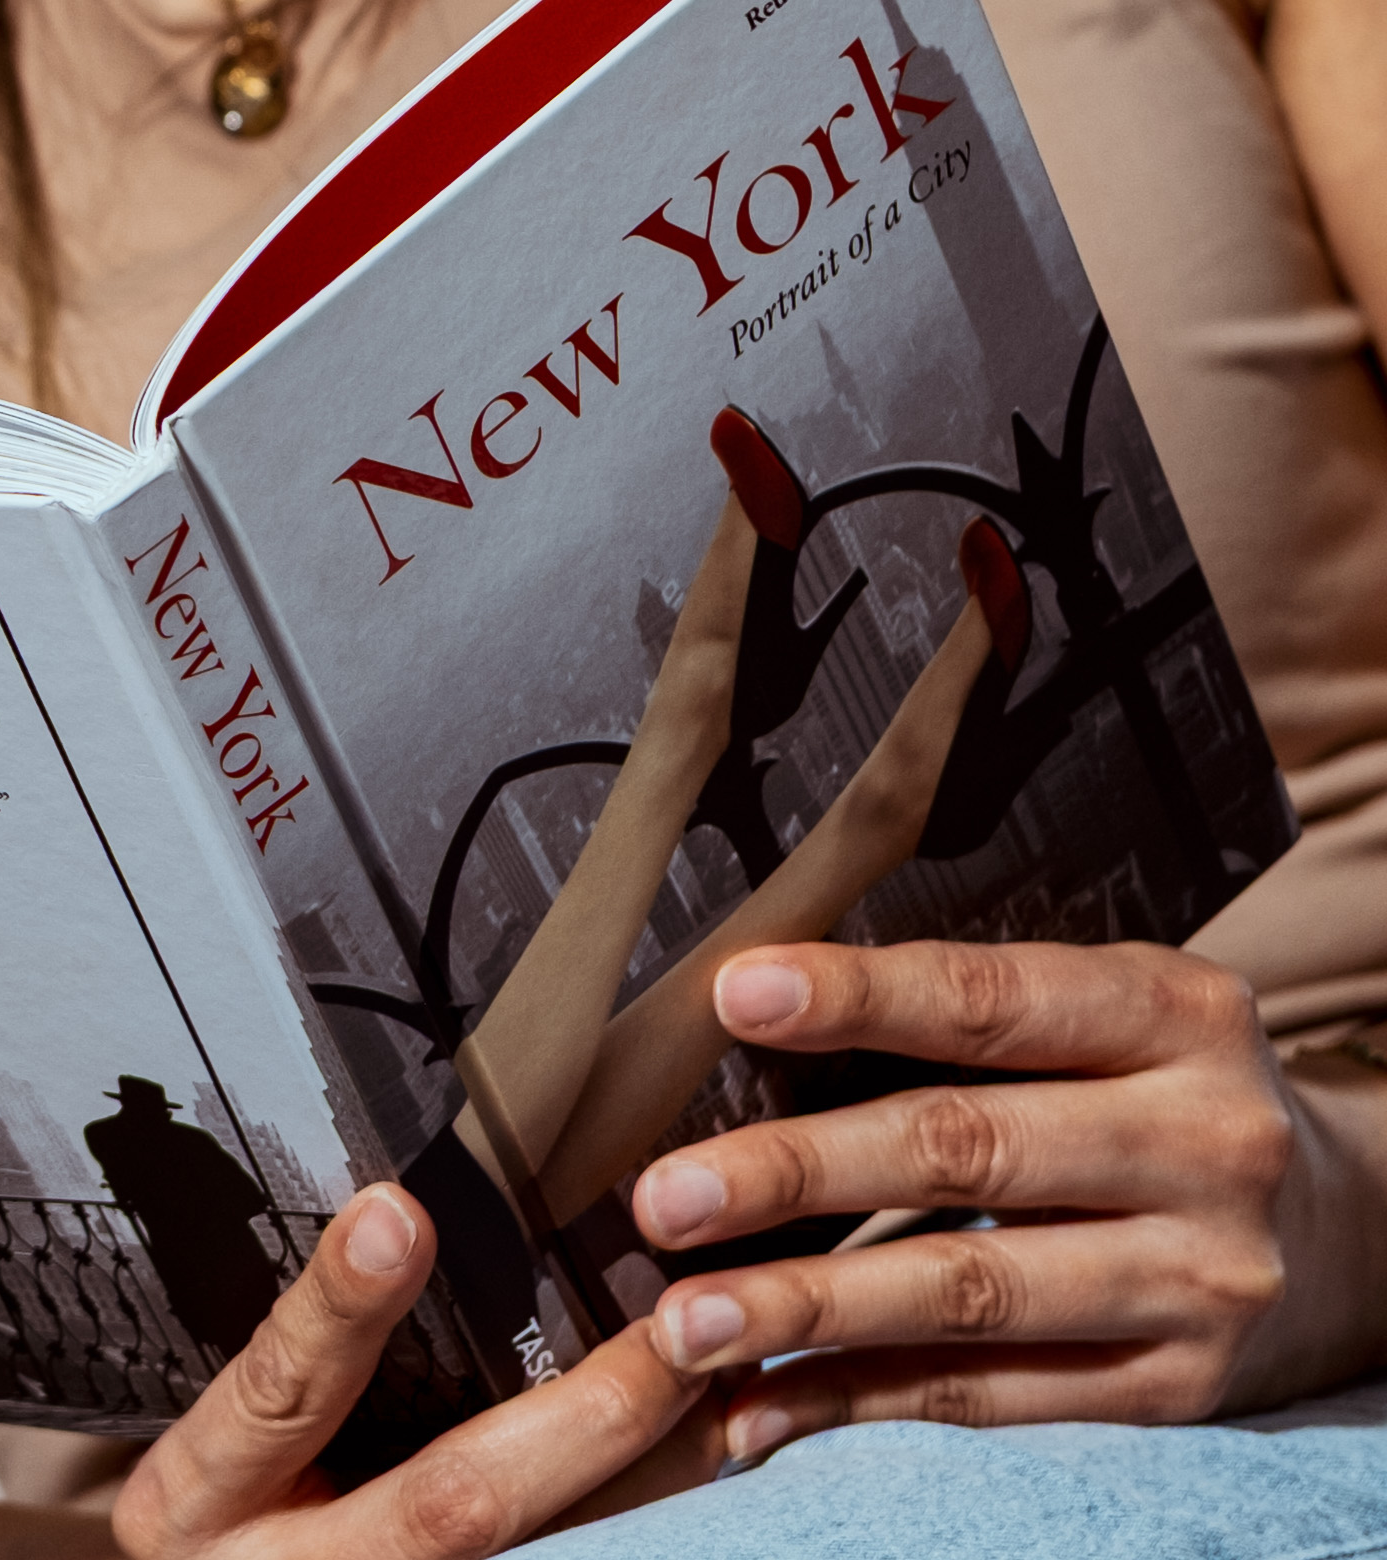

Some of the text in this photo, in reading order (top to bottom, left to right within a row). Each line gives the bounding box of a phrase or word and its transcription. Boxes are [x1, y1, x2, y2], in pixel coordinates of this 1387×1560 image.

[331, 37, 957, 586] New York
[729, 141, 970, 360] Portrait of a City
[124, 513, 309, 857] New York
